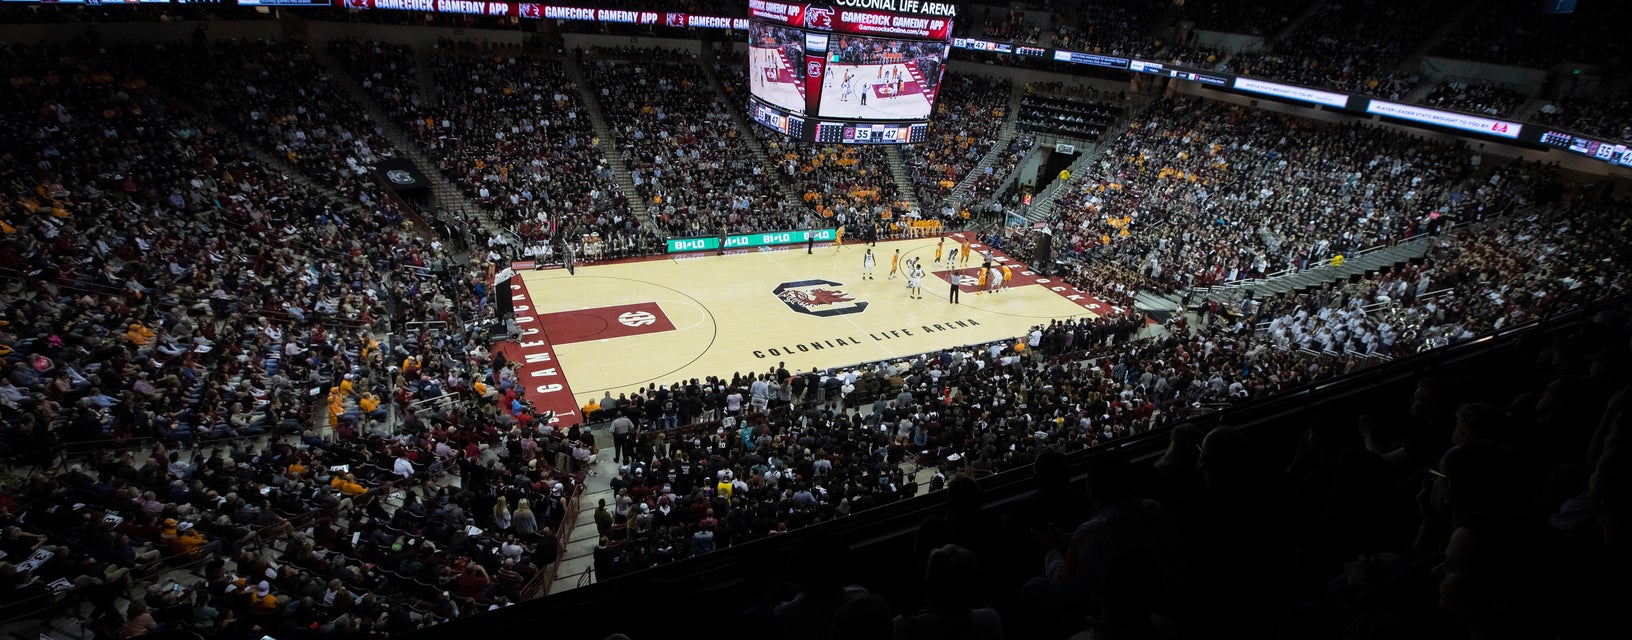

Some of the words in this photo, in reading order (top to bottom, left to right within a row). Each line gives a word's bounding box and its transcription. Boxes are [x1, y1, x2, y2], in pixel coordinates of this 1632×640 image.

[375, 0, 435, 12] GAMECOCK
[438, 0, 485, 14] GAMEDAY
[489, 3, 509, 15] APP
[787, 5, 800, 16] APP
[836, 0, 896, 11] COLONIAL
[900, 0, 920, 13] LIFE
[921, 1, 956, 17] ARENA
[545, 6, 595, 20] GAMECOCK
[598, 10, 638, 23] GAMEDAY
[641, 12, 658, 24] APP
[688, 15, 731, 28] GAMECOCK
[841, 11, 891, 26] GAMECOCK
[892, 16, 929, 29] GAMEDAY
[930, 19, 944, 30] APP
[858, 24, 929, 36] GamecocksOnline.com/App
[975, 41, 985, 49] 47
[1395, 108, 1415, 116] LEADER
[1432, 115, 1458, 123] BROUGHT
[856, 130, 868, 138] 35
[885, 130, 896, 139] 47
[1598, 145, 1611, 157] 35
[752, 336, 861, 359] COLONIAL
[870, 328, 914, 341] LIFE
[921, 318, 980, 334] ARENA
